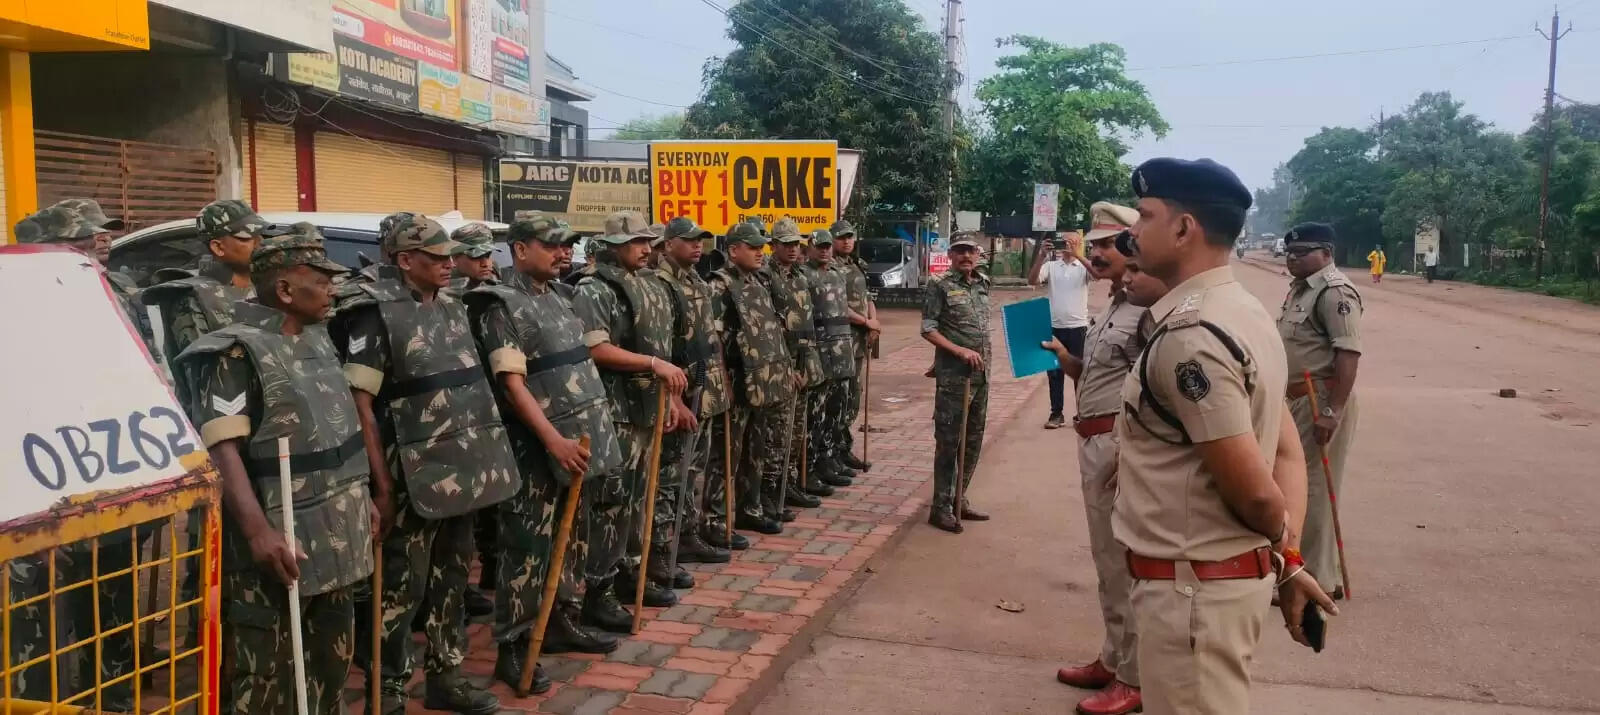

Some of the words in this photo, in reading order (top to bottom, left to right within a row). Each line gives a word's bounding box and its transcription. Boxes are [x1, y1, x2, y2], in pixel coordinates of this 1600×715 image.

[339, 45, 369, 73] KOTA
[369, 56, 417, 87] ACADEMY
[657, 151, 730, 167] EVERYDAY
[525, 165, 569, 182] ARC
[578, 166, 623, 184] KOTA
[658, 169, 708, 197] BUY
[717, 169, 728, 197] 1
[733, 155, 832, 210] CAKE
[575, 204, 606, 212] DROPPER
[659, 199, 707, 226] GET
[717, 199, 728, 226] 1
